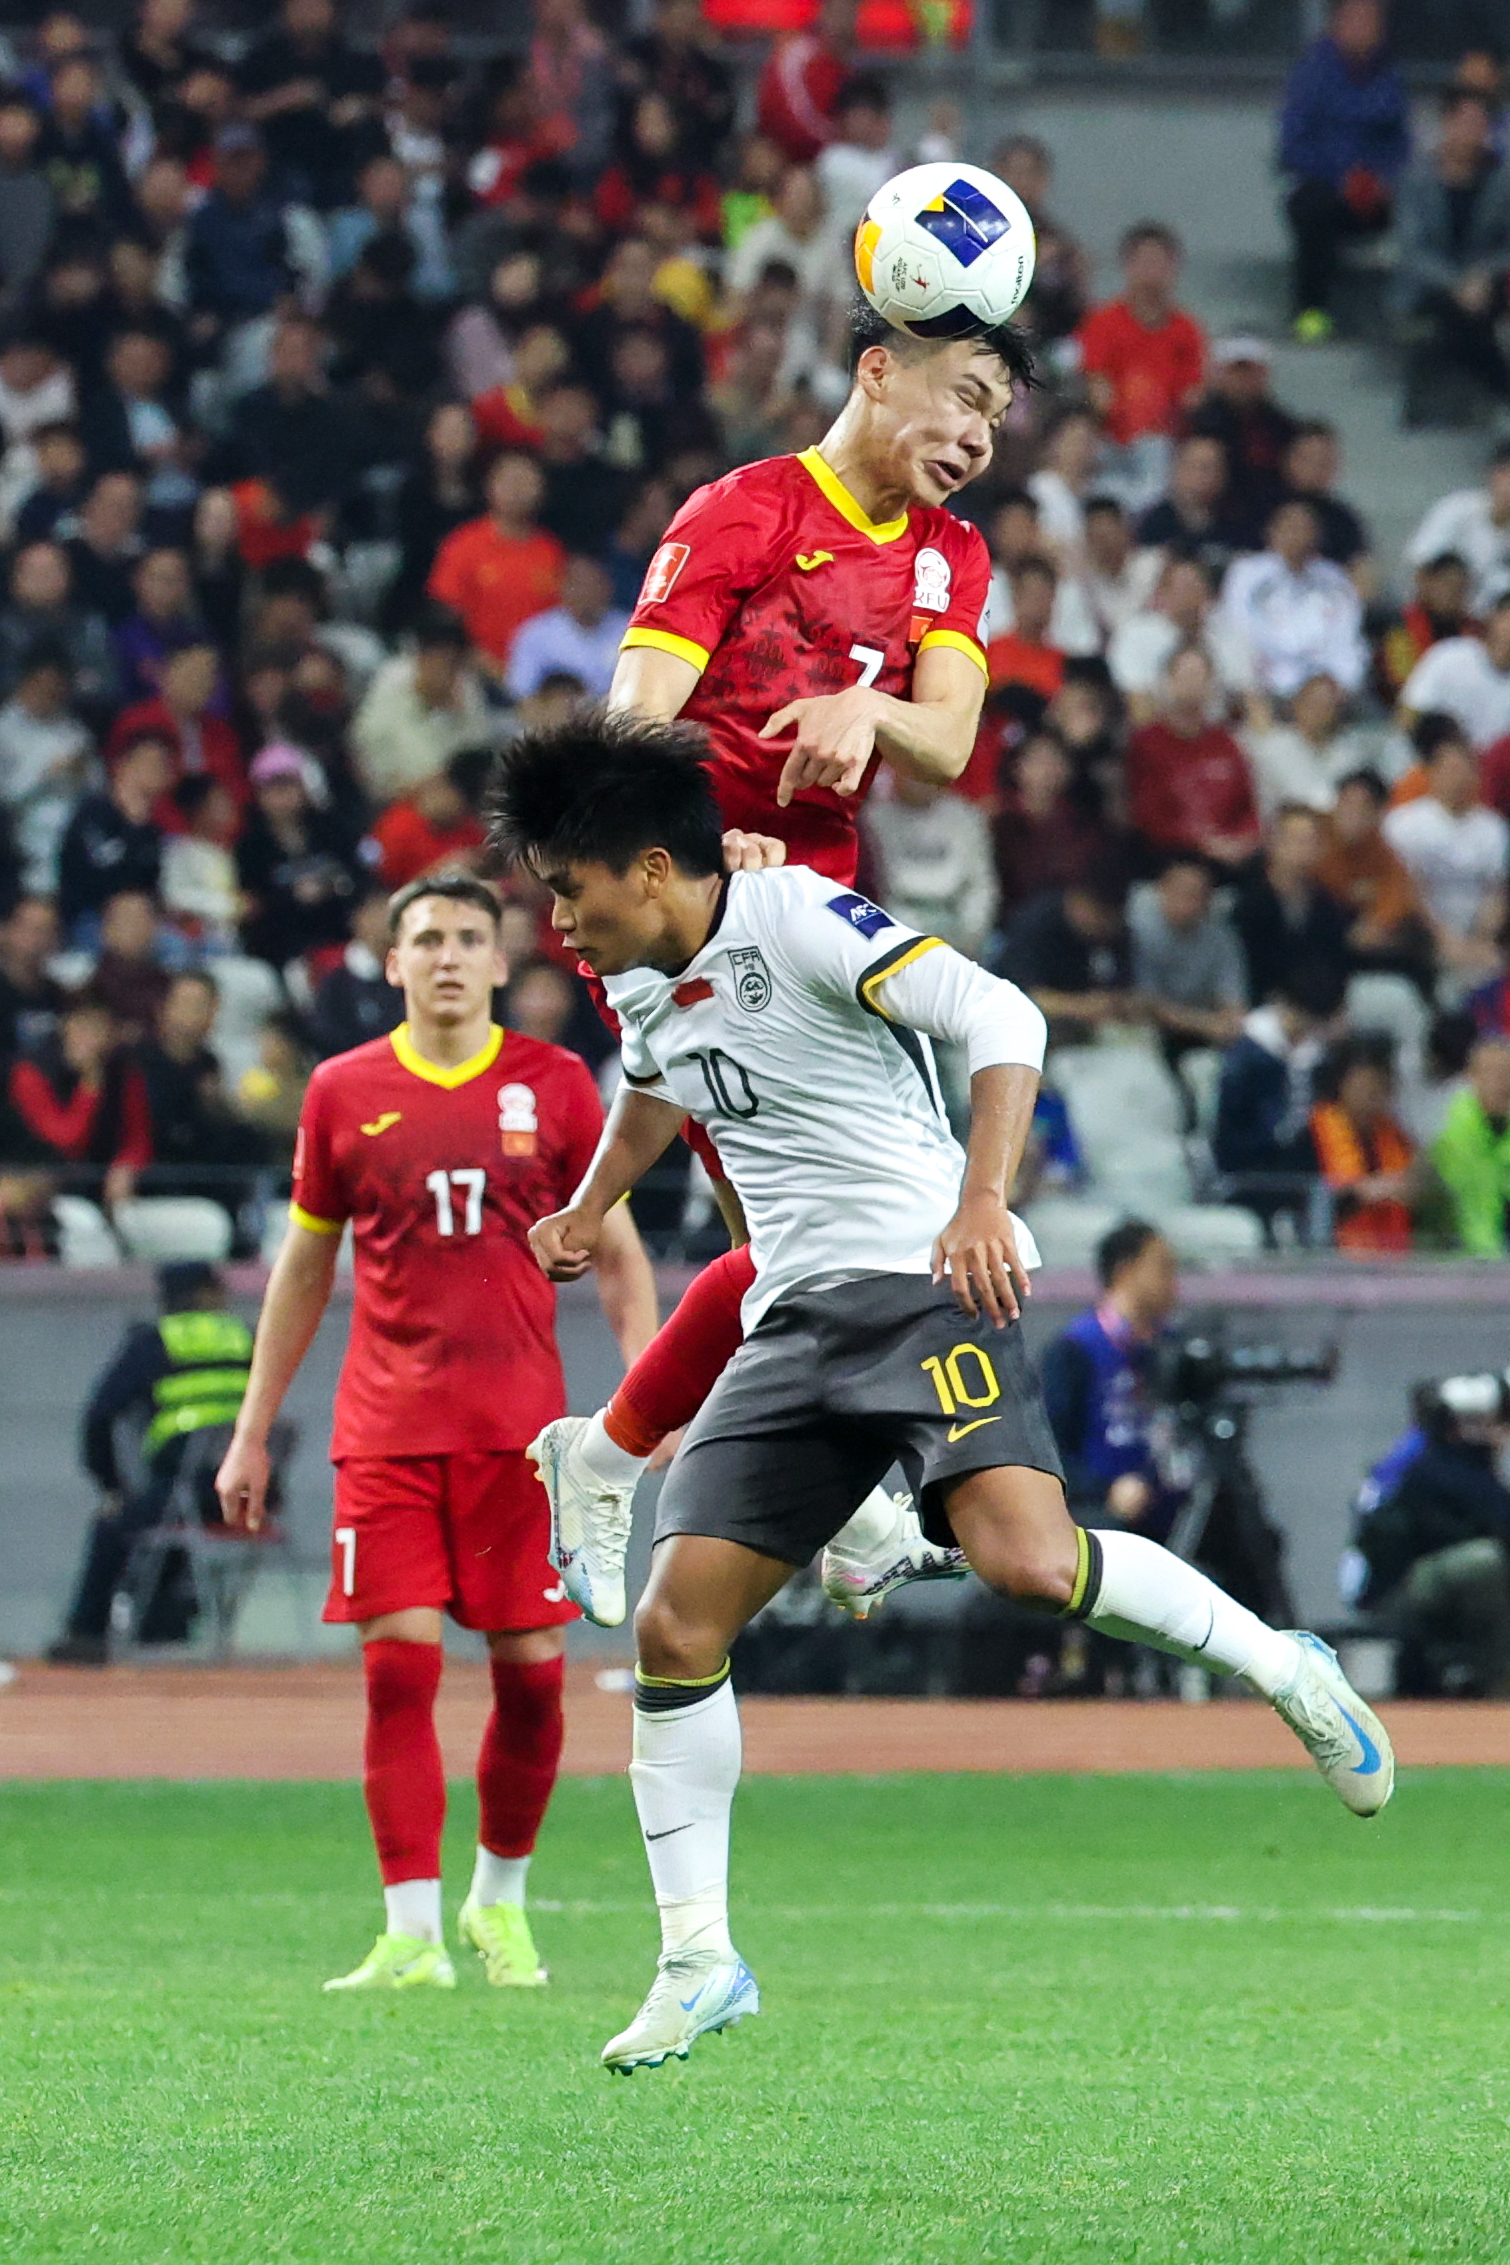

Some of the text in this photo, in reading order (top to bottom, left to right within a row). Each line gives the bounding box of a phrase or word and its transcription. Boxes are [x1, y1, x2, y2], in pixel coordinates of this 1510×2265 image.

[849, 644, 885, 687] 7
[732, 950, 760, 965] CFA
[686, 1048, 759, 1119] 10
[426, 1168, 486, 1236] 17
[920, 1342, 1000, 1414] 10
